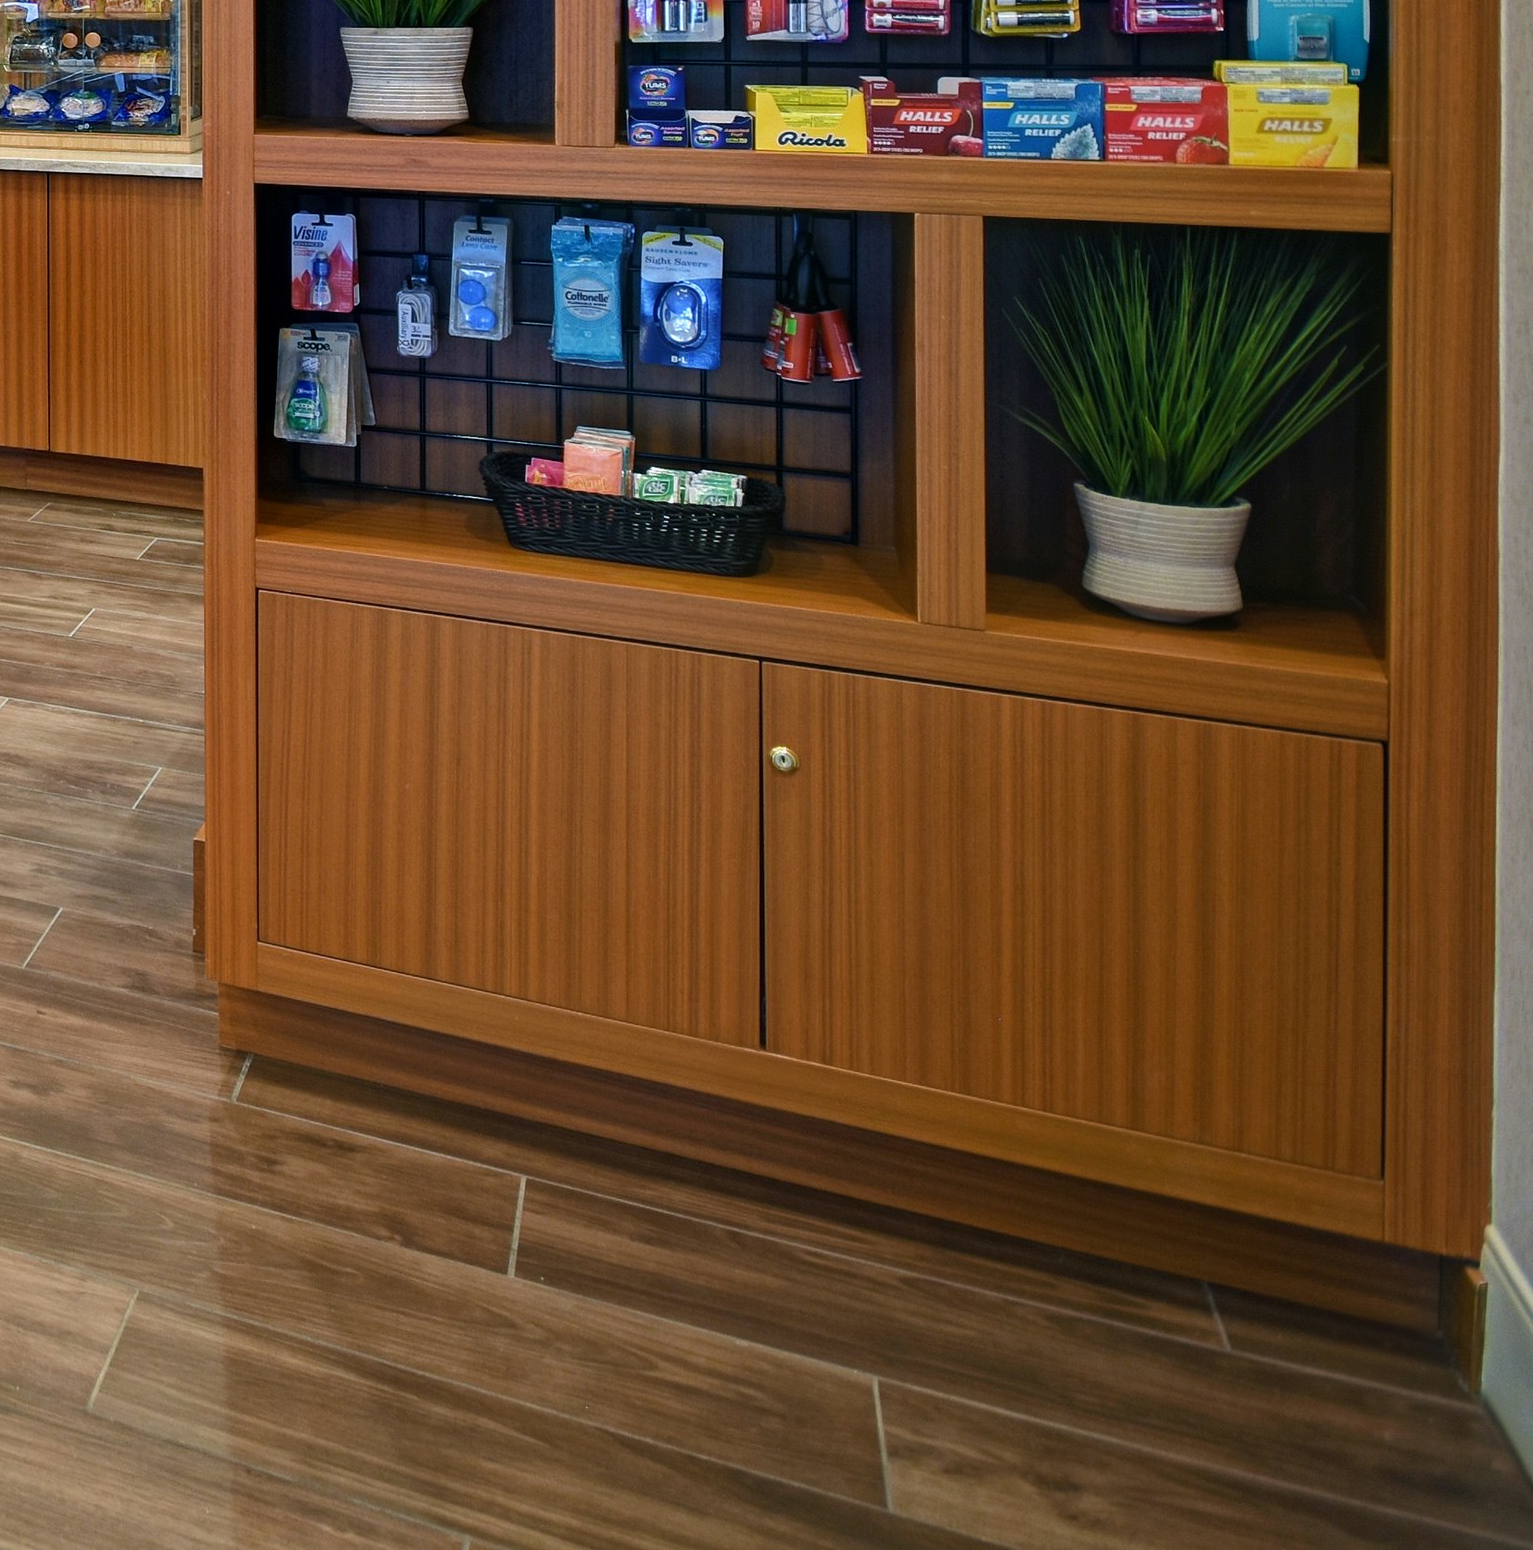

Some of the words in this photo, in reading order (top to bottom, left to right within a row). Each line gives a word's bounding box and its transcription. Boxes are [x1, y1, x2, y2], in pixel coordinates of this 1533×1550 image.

[644, 81, 667, 89] TUMS
[899, 111, 953, 123] HALLS
[1015, 114, 1070, 125] HALLS
[1137, 116, 1195, 128] HALLS
[909, 125, 945, 134] RELIEF
[1263, 120, 1324, 132] HALLS
[1025, 129, 1062, 137] RELIEF
[1147, 132, 1187, 140] RELIEF
[779, 131, 847, 148] Ricola
[293, 225, 328, 241] Visine
[465, 235, 495, 243] Contact
[645, 256, 672, 266] Sight
[674, 257, 708, 268] Savers
[565, 291, 609, 303] Cottonelle
[297, 341, 331, 353] scope
